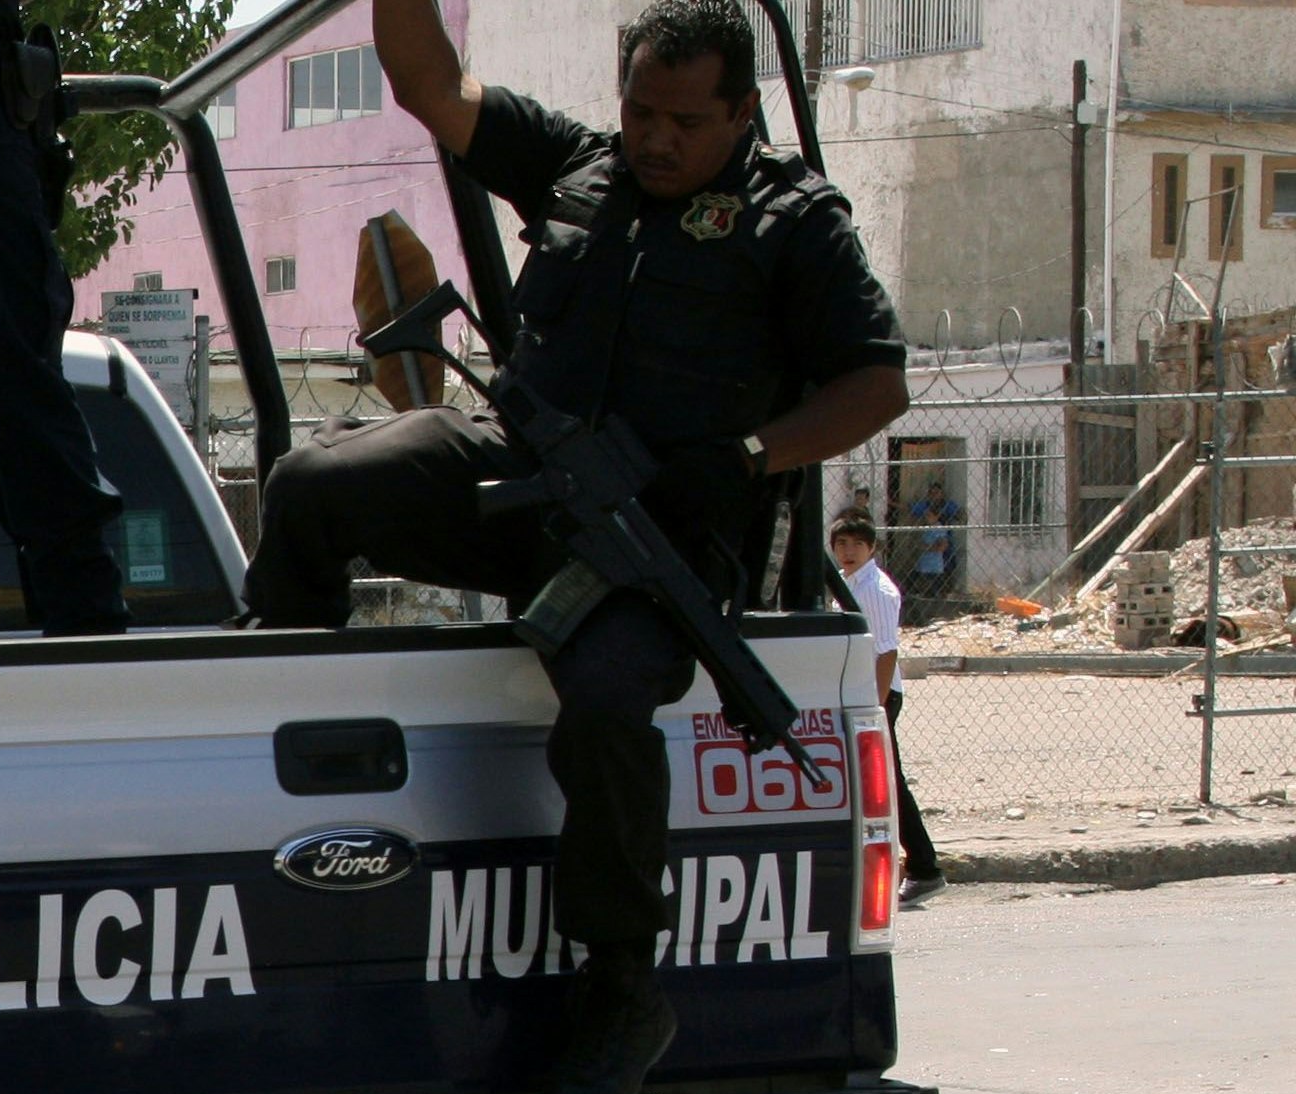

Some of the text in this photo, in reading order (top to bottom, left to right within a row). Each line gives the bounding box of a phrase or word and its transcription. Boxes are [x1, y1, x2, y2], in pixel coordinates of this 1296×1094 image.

[108, 310, 130, 322] QUIEN
[132, 310, 141, 322] SE
[699, 742, 845, 814] 066
[312, 840, 393, 877] Ford
